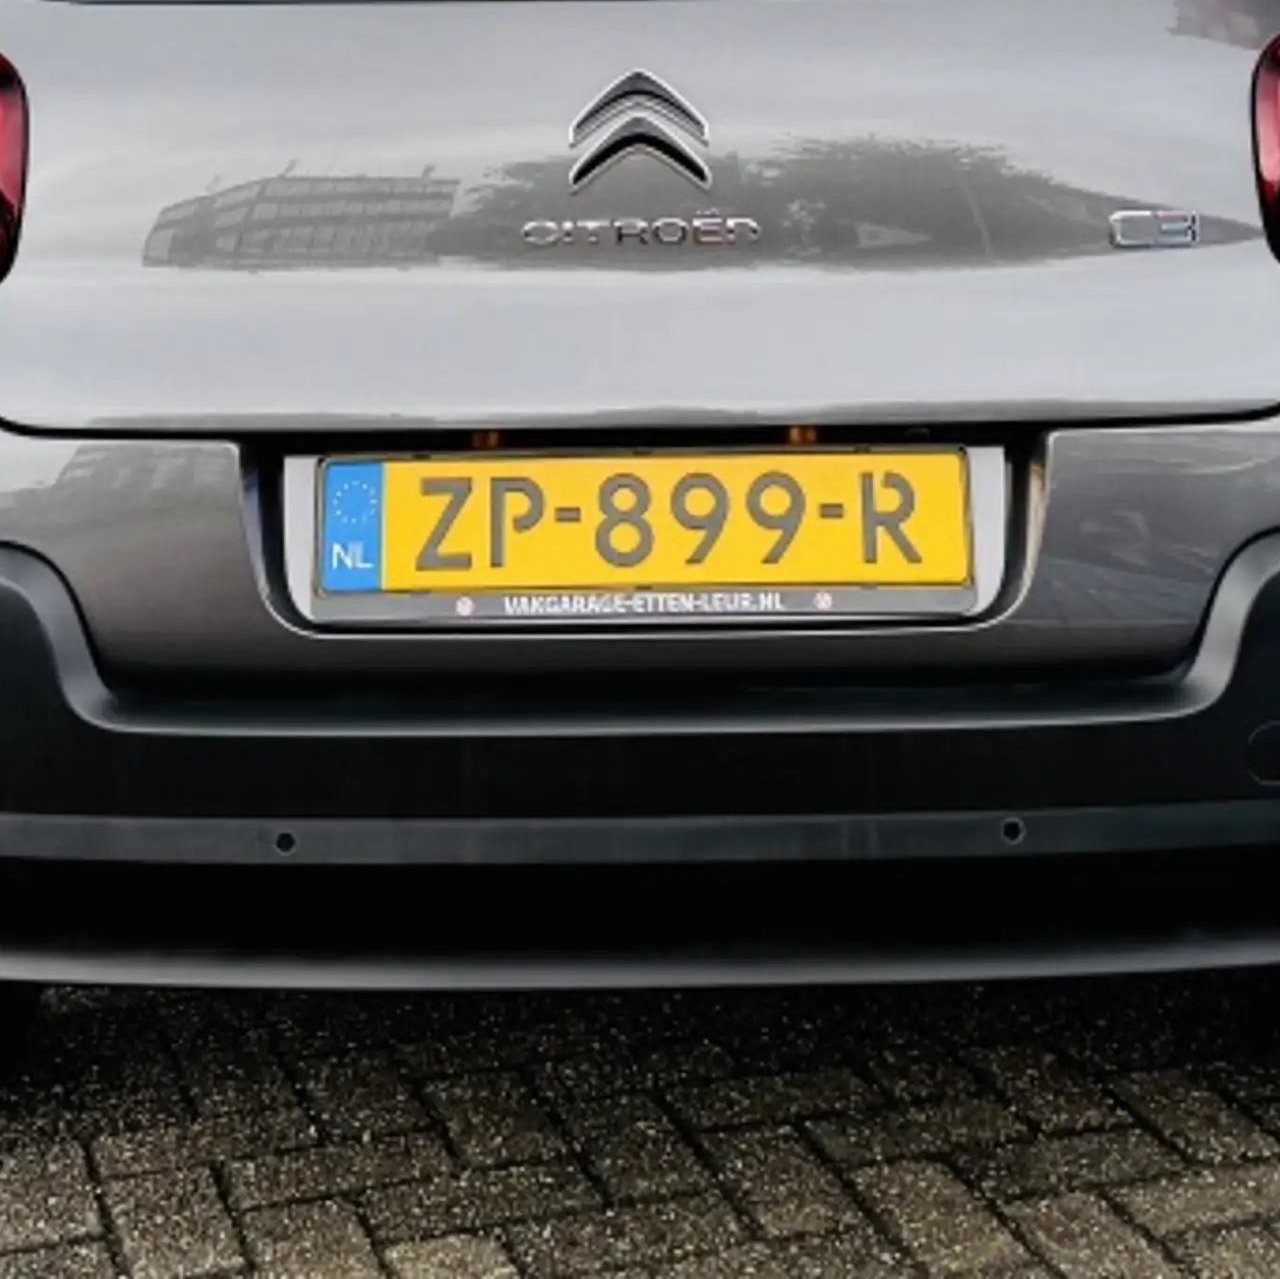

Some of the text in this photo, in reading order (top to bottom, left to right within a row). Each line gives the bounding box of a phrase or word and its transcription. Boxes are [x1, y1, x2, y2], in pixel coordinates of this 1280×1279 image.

[520, 206, 762, 246] CITROËN
[1108, 210, 1200, 247] C3
[415, 470, 922, 572] ZP-899-R
[331, 542, 375, 570] NL
[503, 590, 786, 616] VAKGARAGE-ETTEN-LEUR.NL
